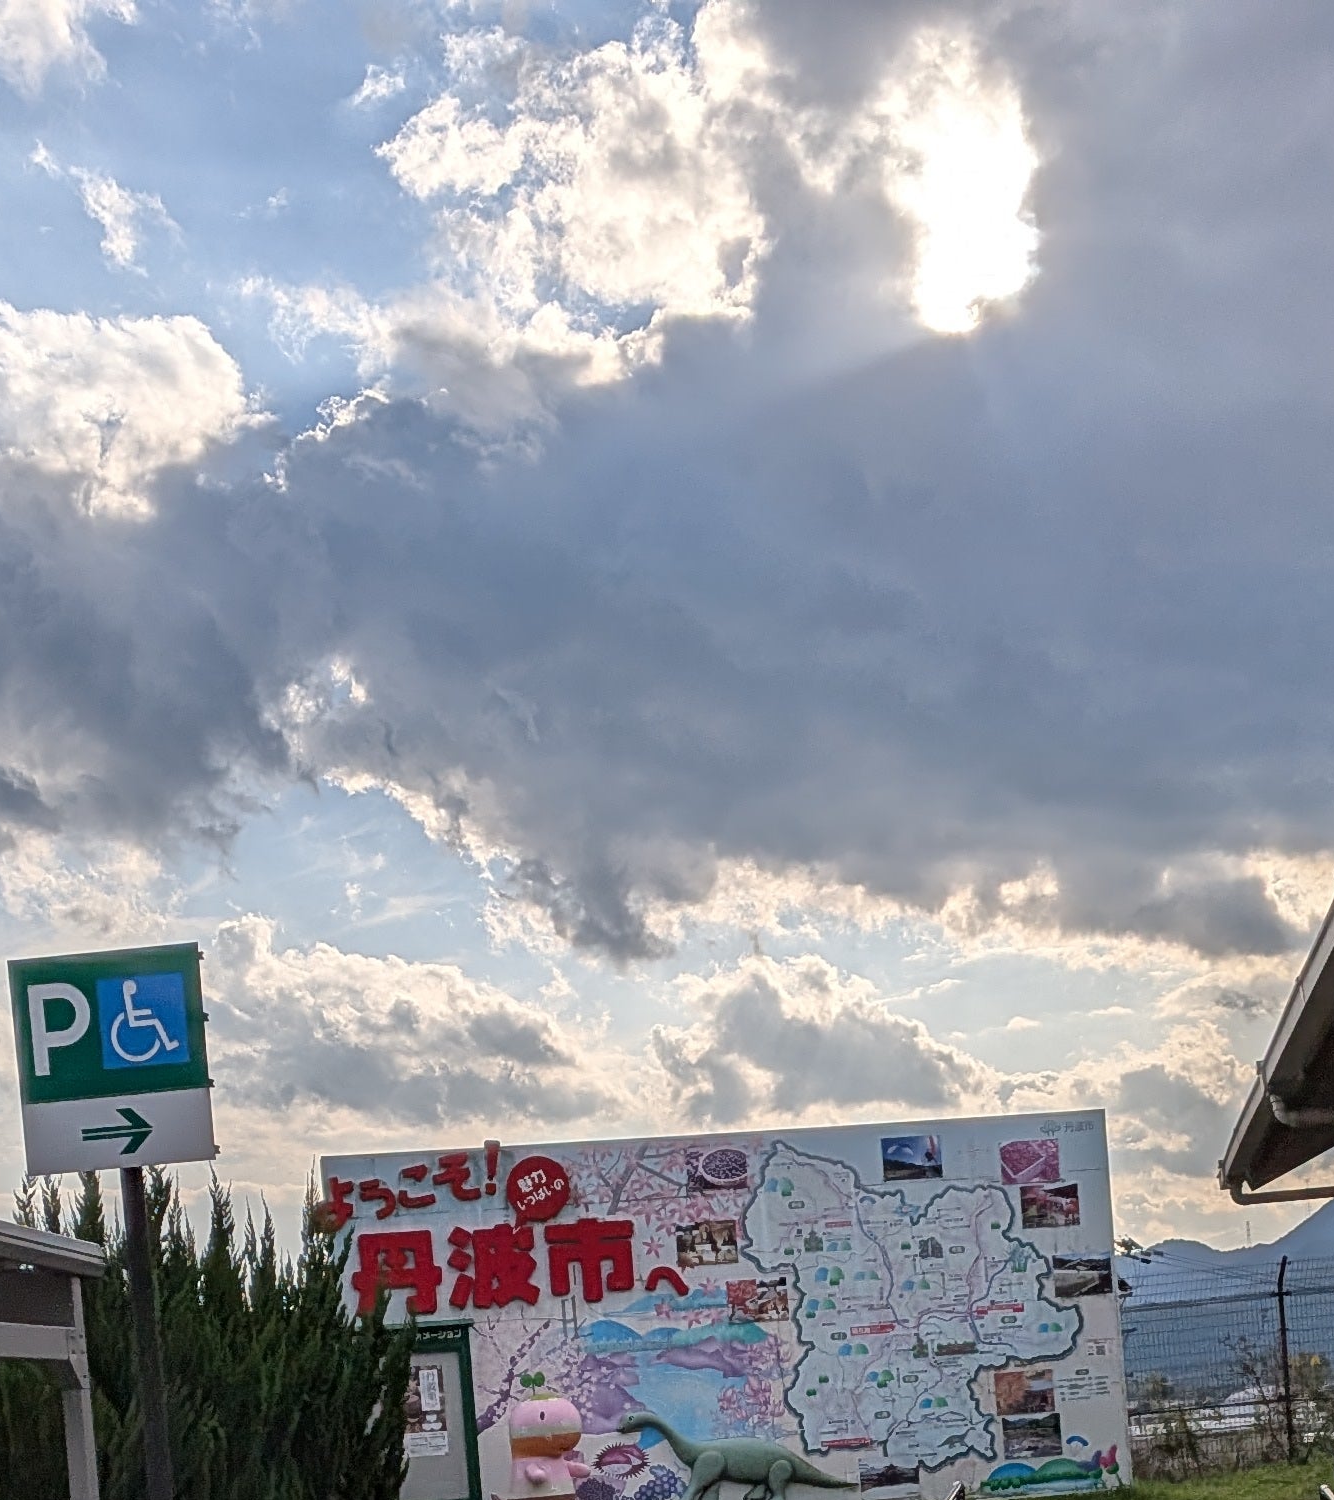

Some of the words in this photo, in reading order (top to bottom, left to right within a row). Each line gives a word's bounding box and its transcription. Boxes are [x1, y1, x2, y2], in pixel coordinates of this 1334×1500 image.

[27, 982, 91, 1077] P
[315, 1140, 501, 1233] ようこそ!
[517, 1169, 547, 1193] 魅力
